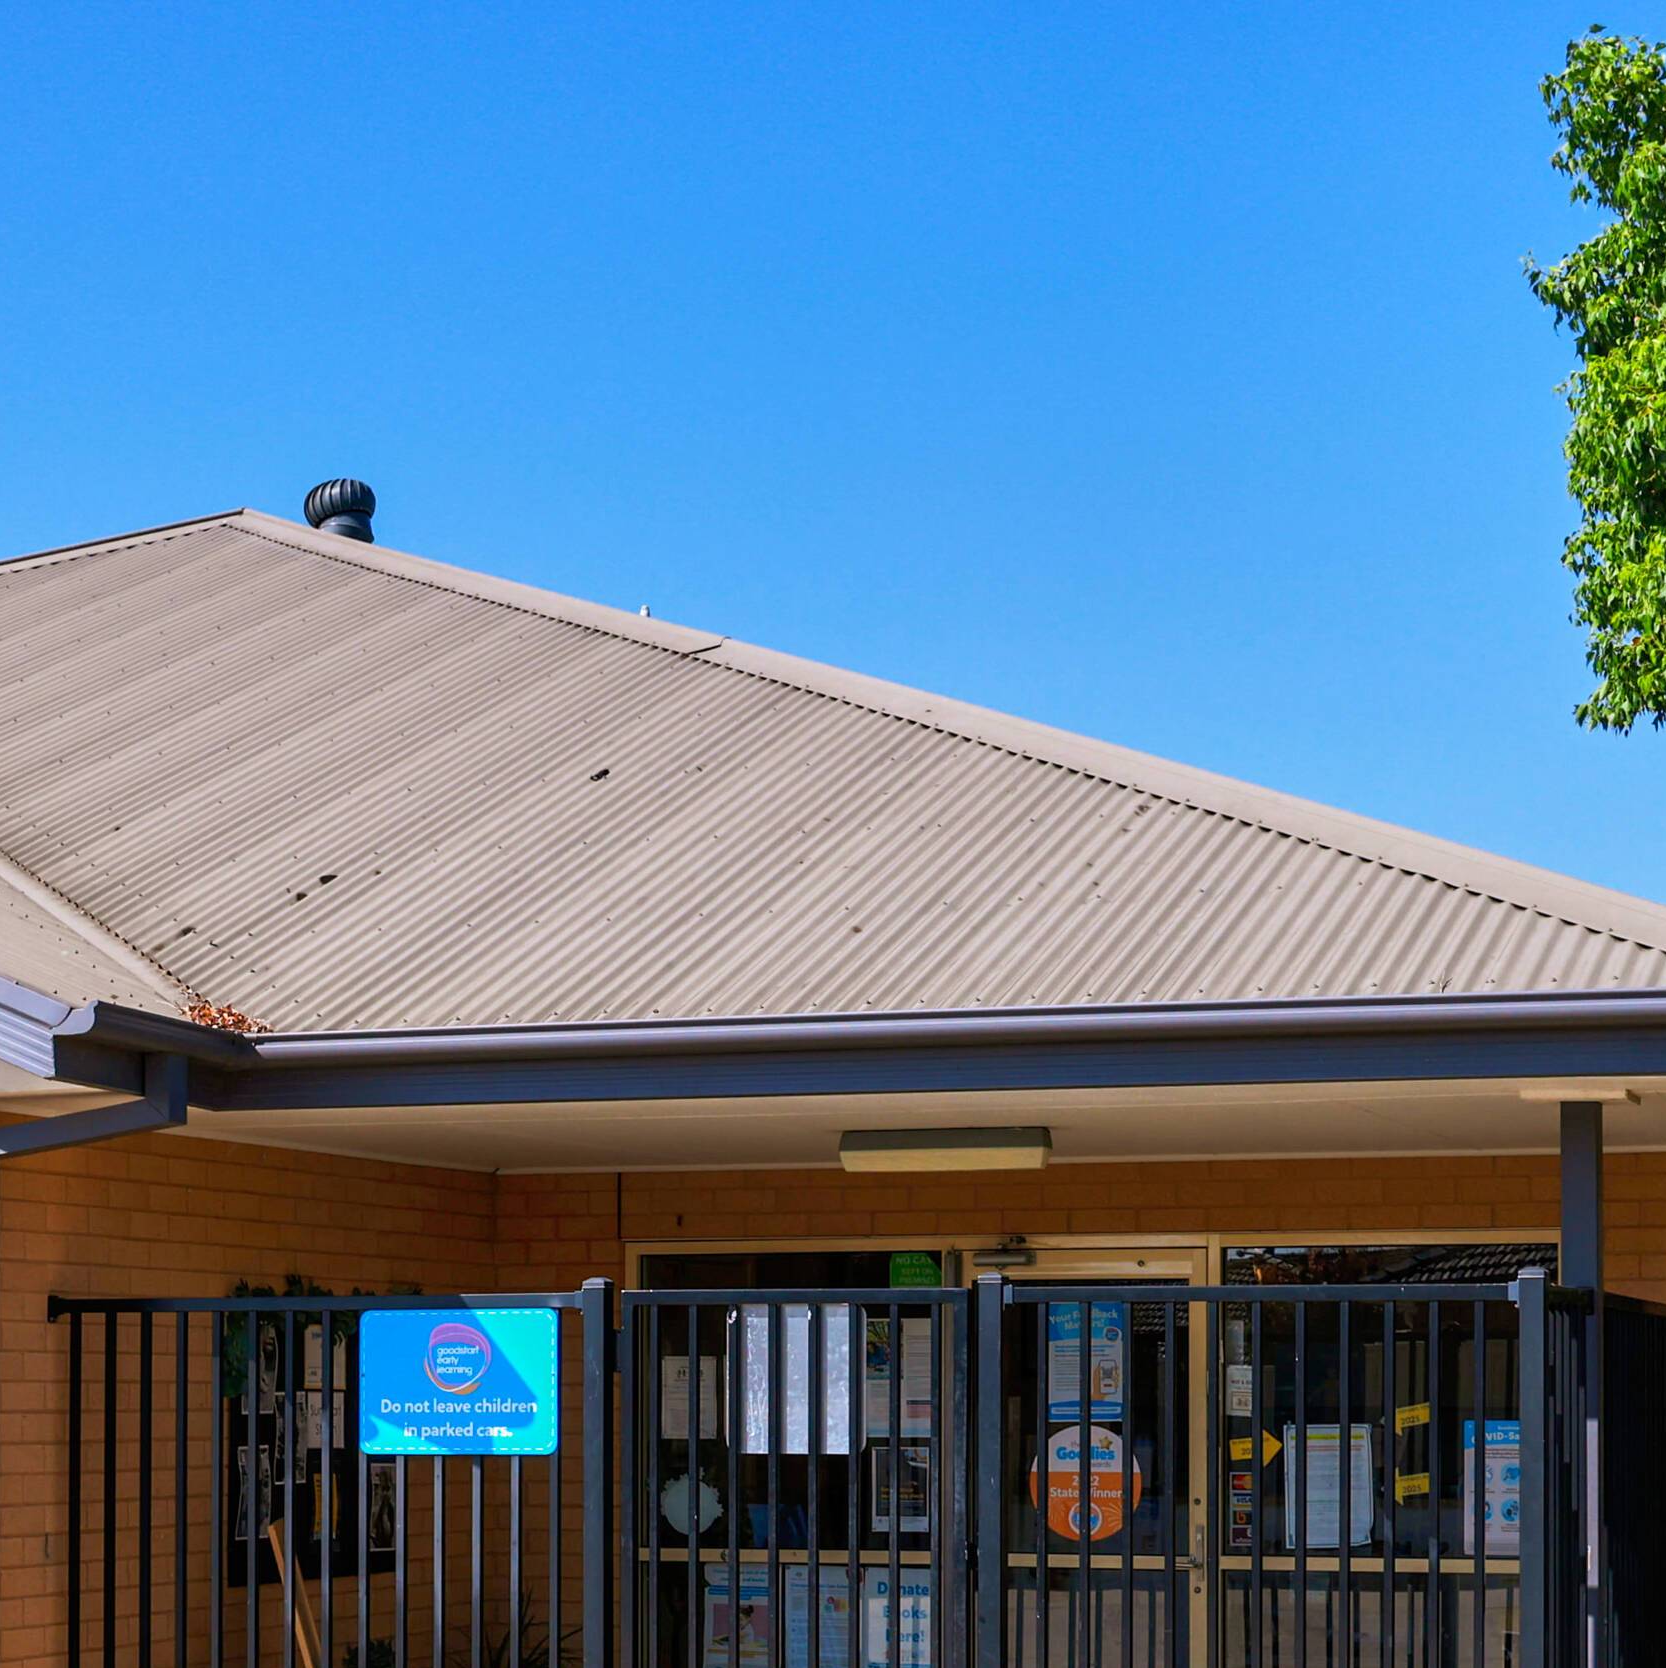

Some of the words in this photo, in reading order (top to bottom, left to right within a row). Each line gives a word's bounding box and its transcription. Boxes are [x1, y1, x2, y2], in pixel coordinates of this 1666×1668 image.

[437, 1345, 479, 1357] goodstart
[437, 1356, 460, 1366] early
[437, 1365, 473, 1377] learning
[380, 1398, 401, 1414] Do
[404, 1399, 430, 1414] not
[433, 1397, 471, 1414] leave
[474, 1397, 538, 1414] children
[403, 1421, 418, 1437] in
[421, 1421, 474, 1441] parked
[476, 1425, 514, 1438] cars.
[877, 1582, 929, 1596] Dnate
